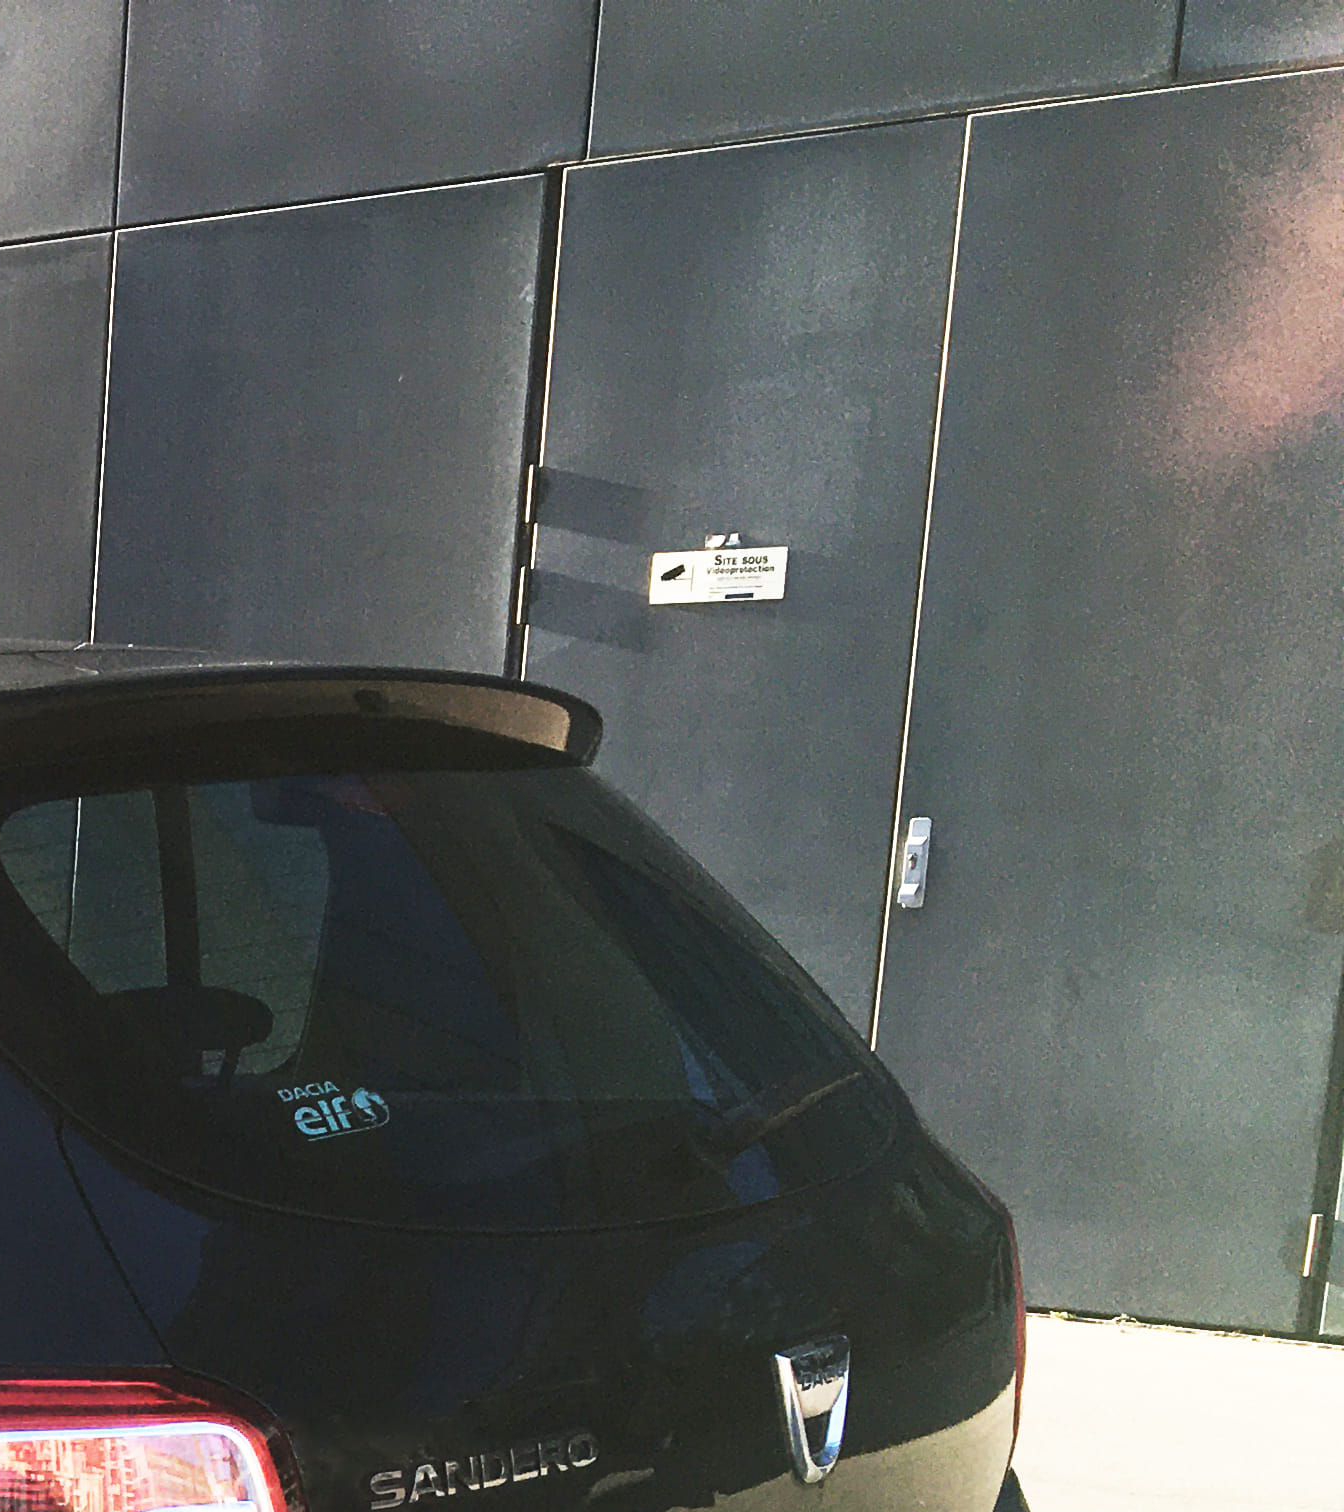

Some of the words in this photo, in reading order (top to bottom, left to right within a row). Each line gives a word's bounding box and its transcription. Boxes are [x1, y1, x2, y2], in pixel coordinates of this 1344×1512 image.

[277, 1080, 340, 1102] DACIA
[294, 1095, 353, 1135] elf
[369, 1433, 599, 1510] SANDERO
